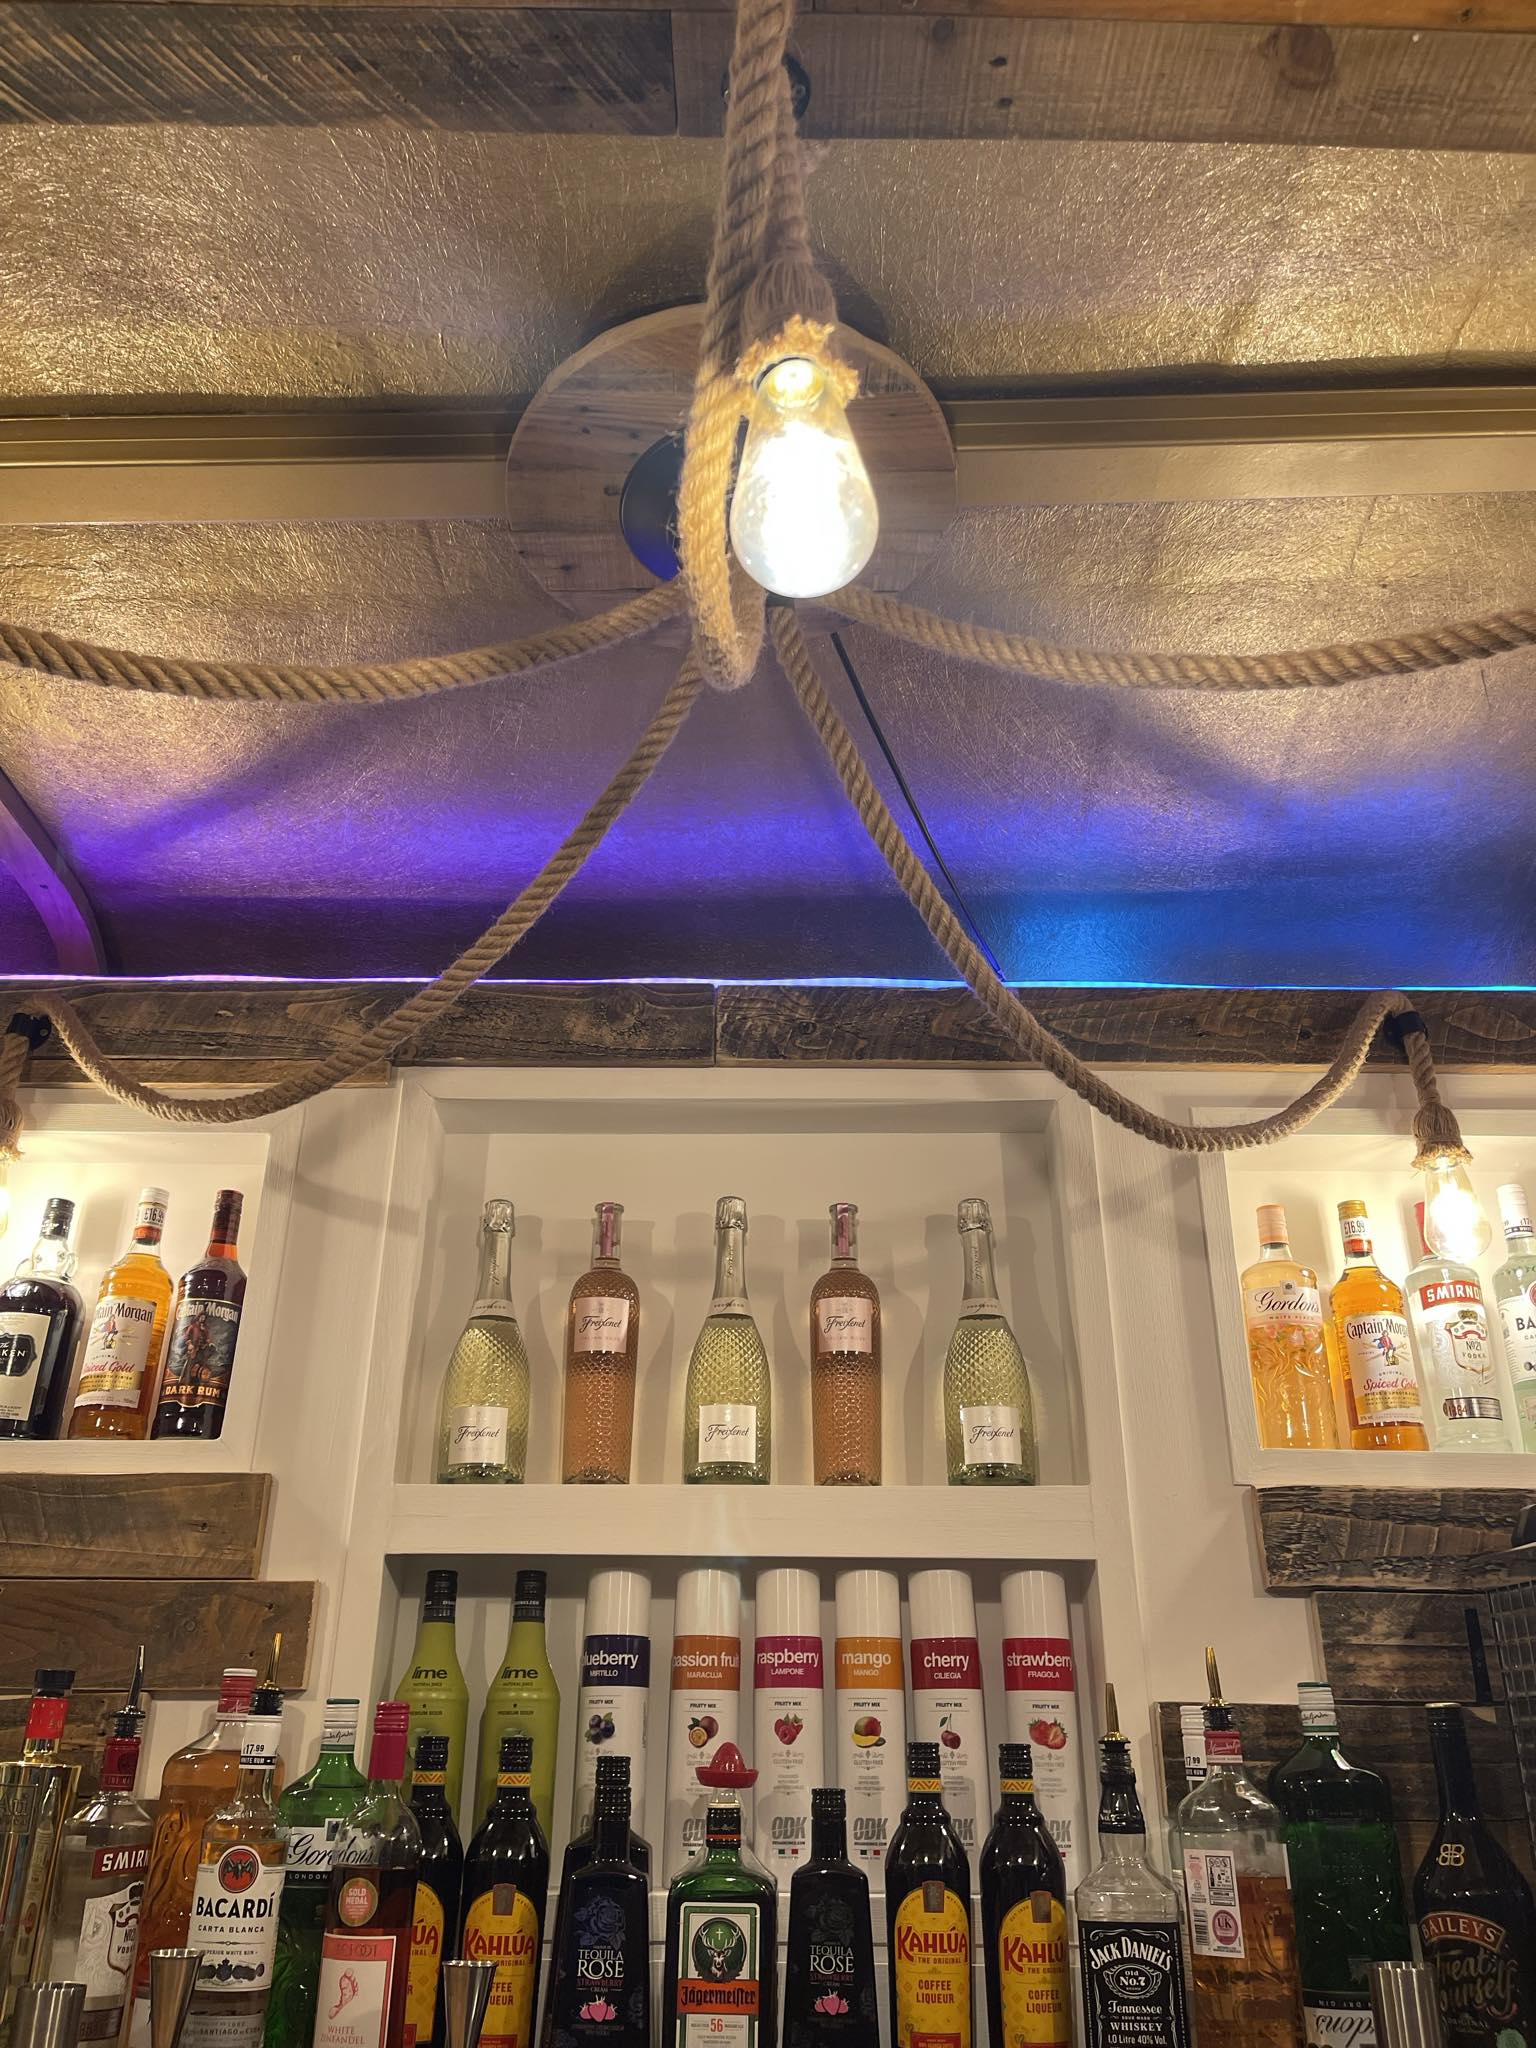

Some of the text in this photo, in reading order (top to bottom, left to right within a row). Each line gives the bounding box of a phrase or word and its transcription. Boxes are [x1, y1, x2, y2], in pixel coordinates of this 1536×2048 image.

[1344, 1219, 1366, 1236] £16.99
[1426, 1284, 1482, 1303] SMIRNO
[114, 1302, 153, 1324] Morgan
[205, 1302, 239, 1322] Morgan
[579, 1315, 623, 1334] Freixenet
[823, 1315, 866, 1334] Freixenet
[1346, 1319, 1384, 1339] Captain
[109, 1361, 135, 1373] Gold
[165, 1385, 220, 1397] DARK RUM
[1363, 1377, 1398, 1391] Spiced
[454, 1425, 500, 1444] Freixenet
[704, 1424, 750, 1442] Freixenet
[969, 1425, 1015, 1444] Freixenet
[756, 1649, 819, 1666] raspberry
[841, 1652, 892, 1668] mango
[924, 1652, 969, 1671] cherry
[412, 1666, 448, 1679] lime
[501, 1666, 538, 1679] lime
[589, 1669, 618, 1677] MIRTILLO
[687, 1671, 722, 1679] MARACUJA
[771, 1668, 804, 1676] LAMPONE
[853, 1669, 879, 1677] MANGO
[1028, 1670, 1059, 1678] FRAGOLA
[682, 1818, 706, 1841] OD
[771, 1816, 807, 1839] ODK
[853, 1817, 888, 1840] ODK
[952, 1818, 974, 1840] DK
[1047, 1819, 1072, 1842] DK
[348, 1887, 367, 1897] GOLD
[196, 1891, 275, 1919] BACARDÍ
[345, 1896, 369, 1905] MEDAL
[198, 1924, 265, 1933] CARTA BLANCA
[1217, 1917, 1232, 1930] UK
[1421, 1917, 1497, 1943] BAILEYS
[464, 1927, 535, 1966] KAHLÚA
[809, 1945, 853, 1957] TEQUILA
[897, 1925, 969, 1964] KAHLÚA
[577, 1949, 624, 1961] TEQUILA
[1089, 1936, 1173, 1971] JACK DANIEL'S
[809, 1955, 855, 1975] ROSE
[933, 1957, 961, 1965] ORIGINAL
[577, 1960, 625, 1980] ROSE
[490, 1982, 512, 1993] FFEE
[577, 1979, 624, 1988] STRAWBERRY
[918, 1979, 952, 1991] COFFEE
[1119, 1976, 1146, 1986] No.7
[916, 1992, 955, 2004] LIQUEUR
[1028, 1989, 1060, 2001] COFFEE
[1108, 2000, 1163, 2014] Tennessee
[200, 2028, 238, 2036] SANTIAGO
[328, 2025, 355, 2035] WHITE
[710, 2018, 723, 2032] 56
[1110, 2022, 1163, 2031] WHISKEY
[1118, 2034, 1136, 2044] Litre
[1137, 2034, 1153, 2045] 40%
